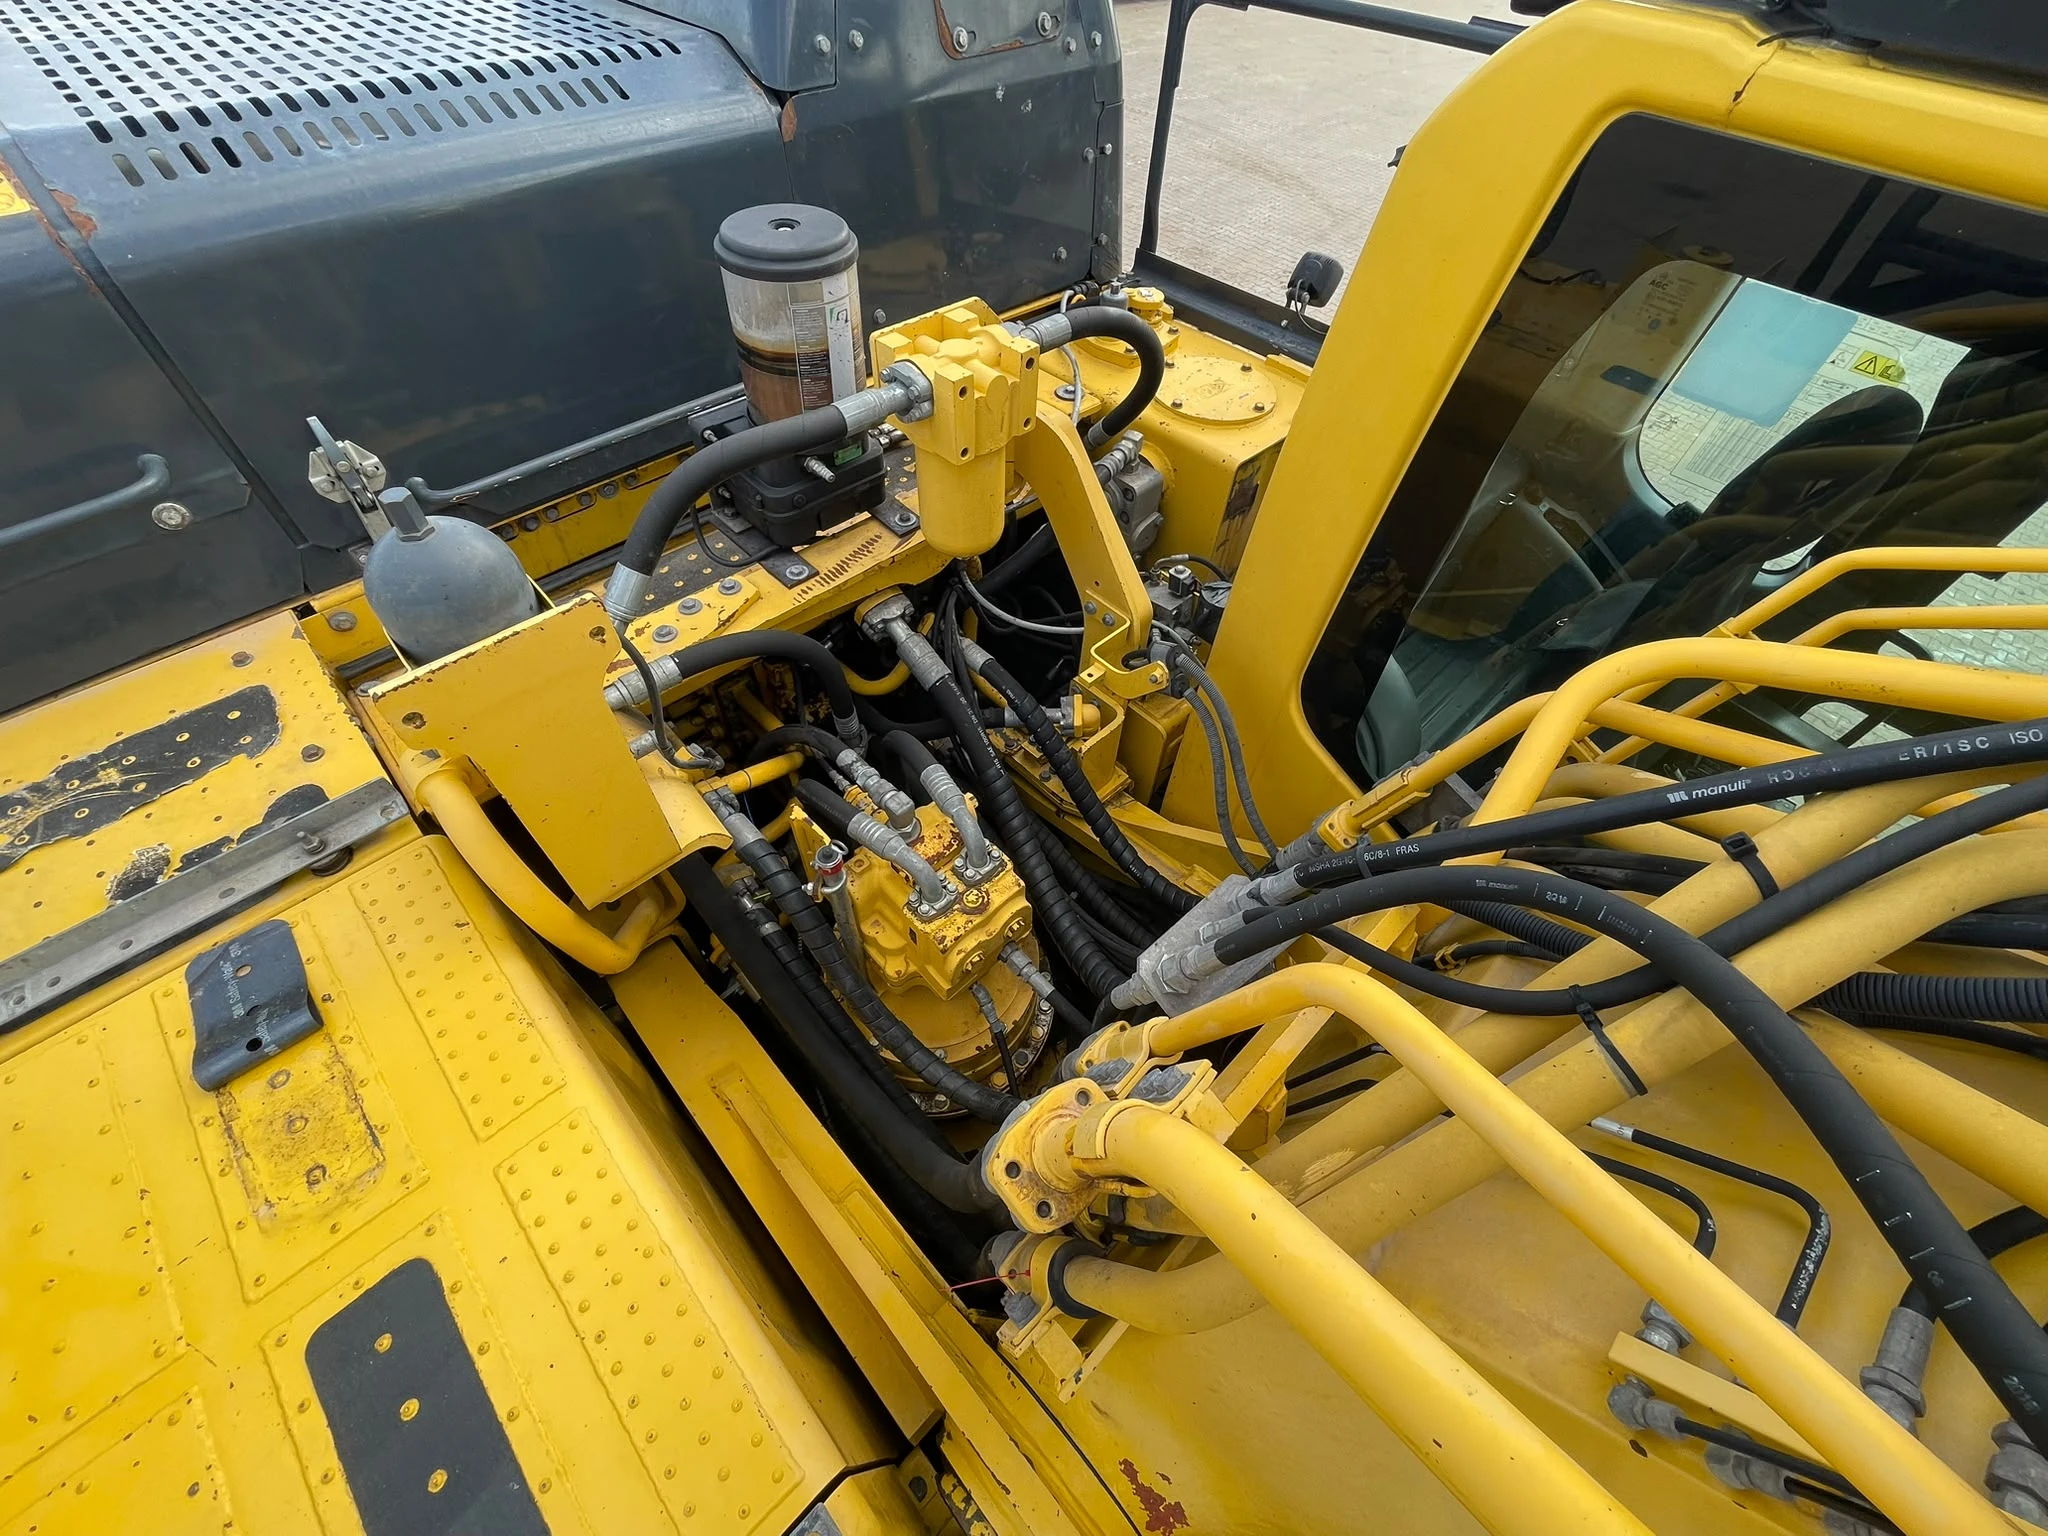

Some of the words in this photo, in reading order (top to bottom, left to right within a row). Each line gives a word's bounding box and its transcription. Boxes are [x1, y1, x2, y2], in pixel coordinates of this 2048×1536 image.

[1648, 280, 1669, 291] AGC
[1691, 779, 1747, 800] manuli
[2008, 728, 2044, 745] ISO
[1395, 843, 1420, 856] FRAS
